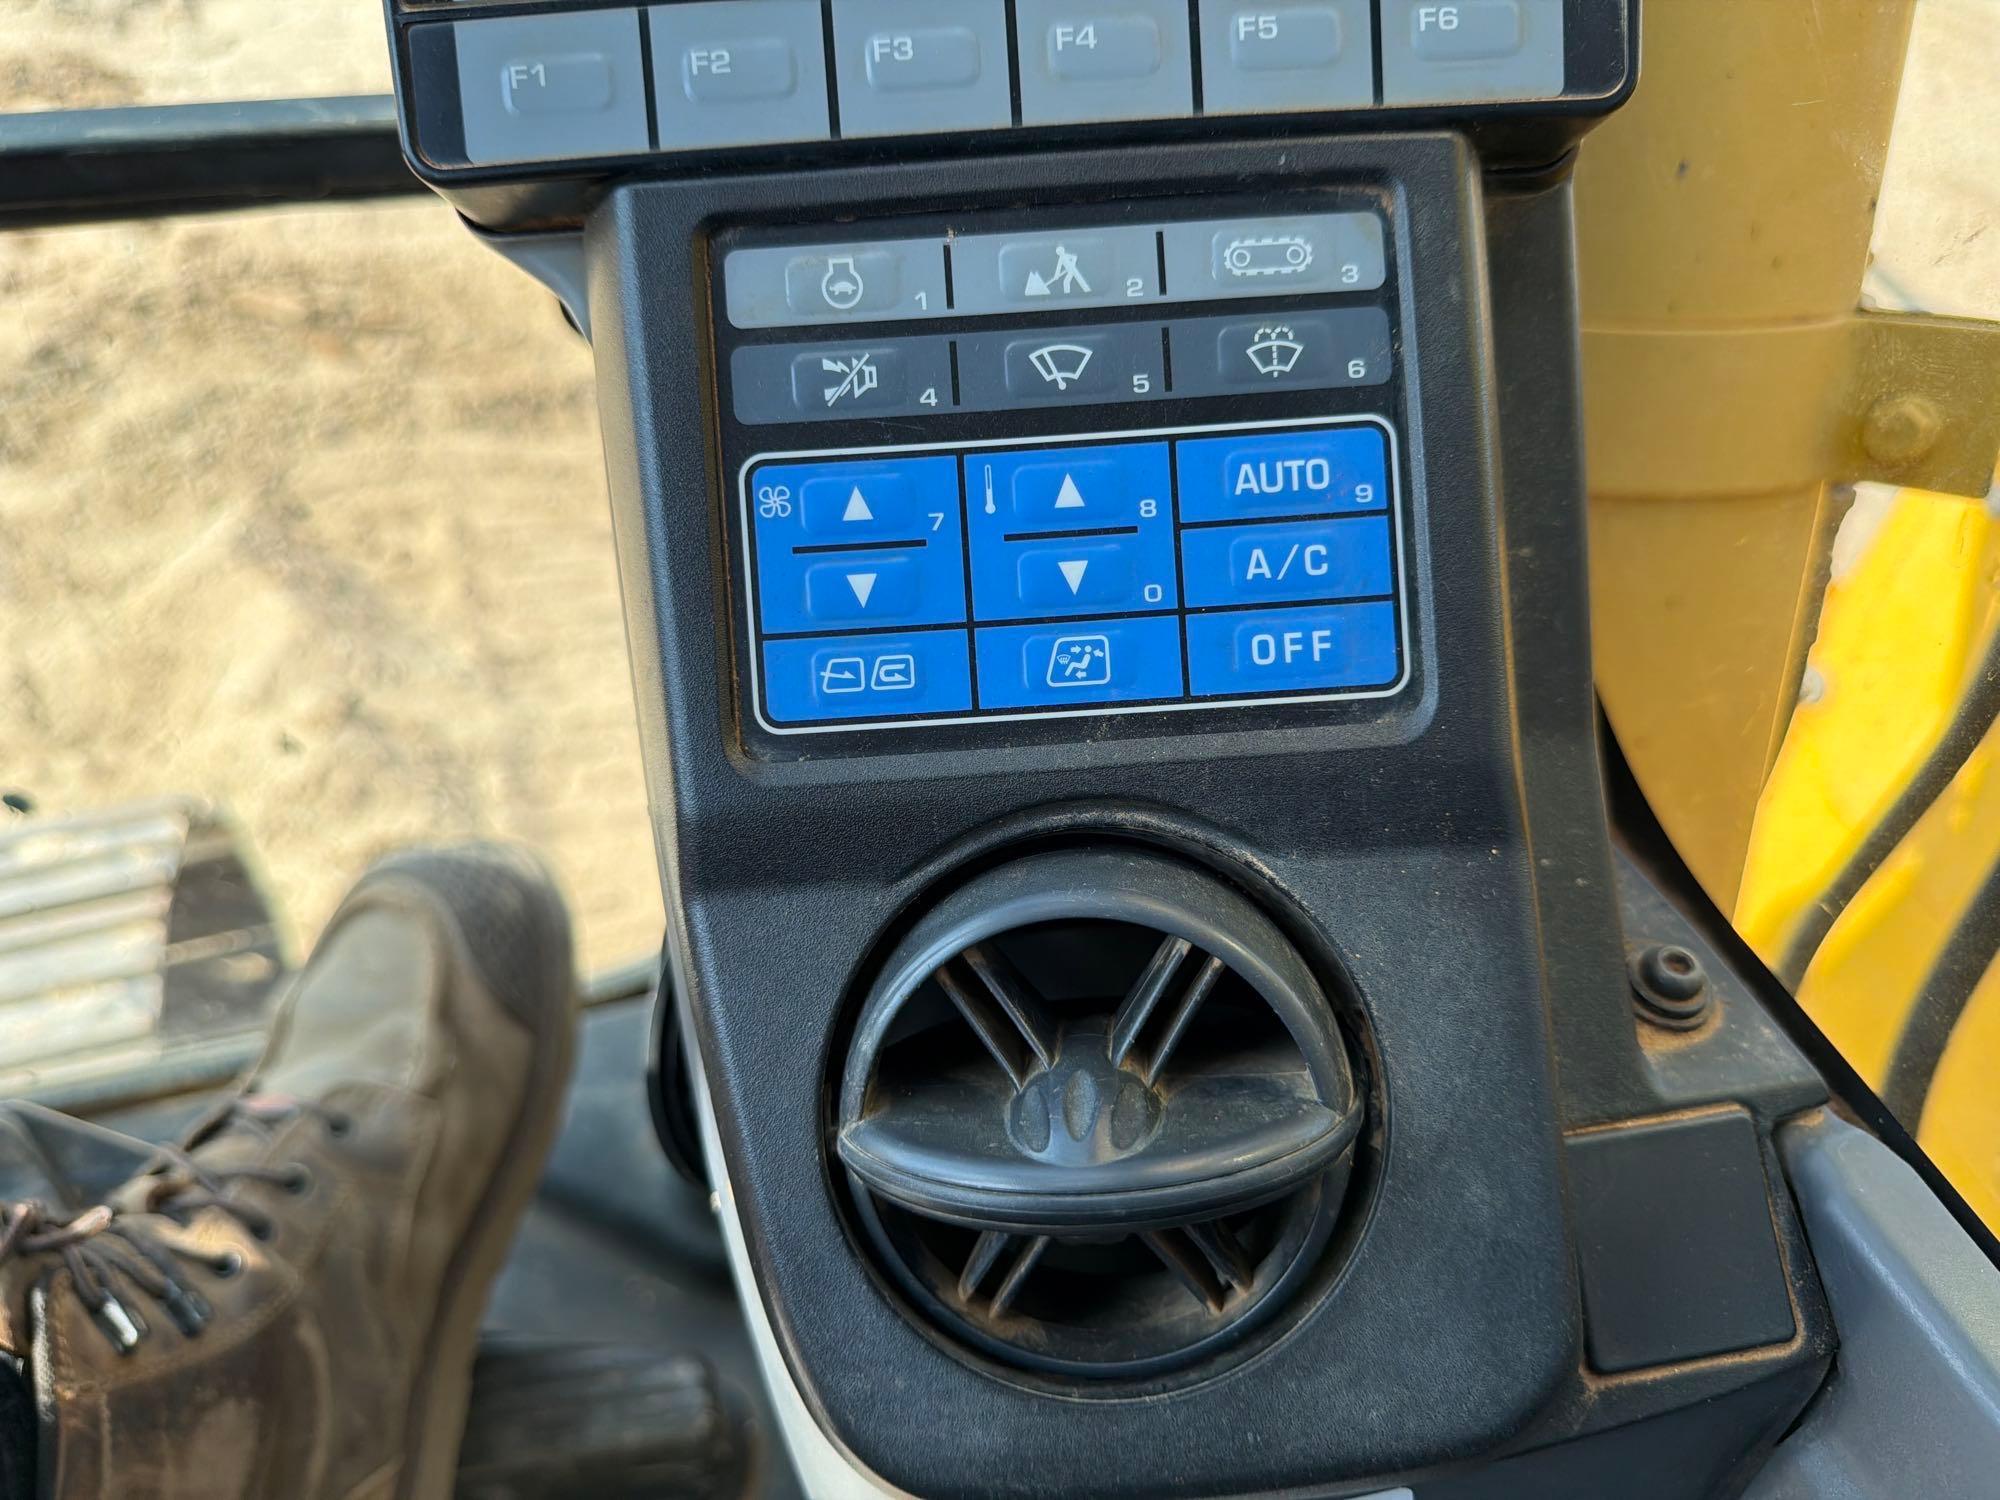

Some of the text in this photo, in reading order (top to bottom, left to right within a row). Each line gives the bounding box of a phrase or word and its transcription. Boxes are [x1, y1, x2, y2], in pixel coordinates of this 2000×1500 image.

[1238, 15, 1279, 41] F5
[1418, 6, 1460, 31] F6
[1055, 25, 1098, 51] F4
[873, 36, 914, 63] F3
[690, 49, 731, 76] F2
[510, 64, 547, 89] F1
[1341, 264, 1359, 284] 3
[1125, 278, 1144, 297] 2
[914, 291, 929, 311] 1
[1347, 359, 1366, 379] 6
[1132, 373, 1151, 393] 5
[919, 387, 938, 407] 4
[1234, 458, 1330, 496] AUTO
[1354, 484, 1374, 504] 9
[1138, 499, 1157, 518] 8
[928, 512, 945, 532] 7
[1246, 544, 1329, 581] A/C
[1144, 584, 1163, 603] 0
[1251, 629, 1332, 667] OFF
